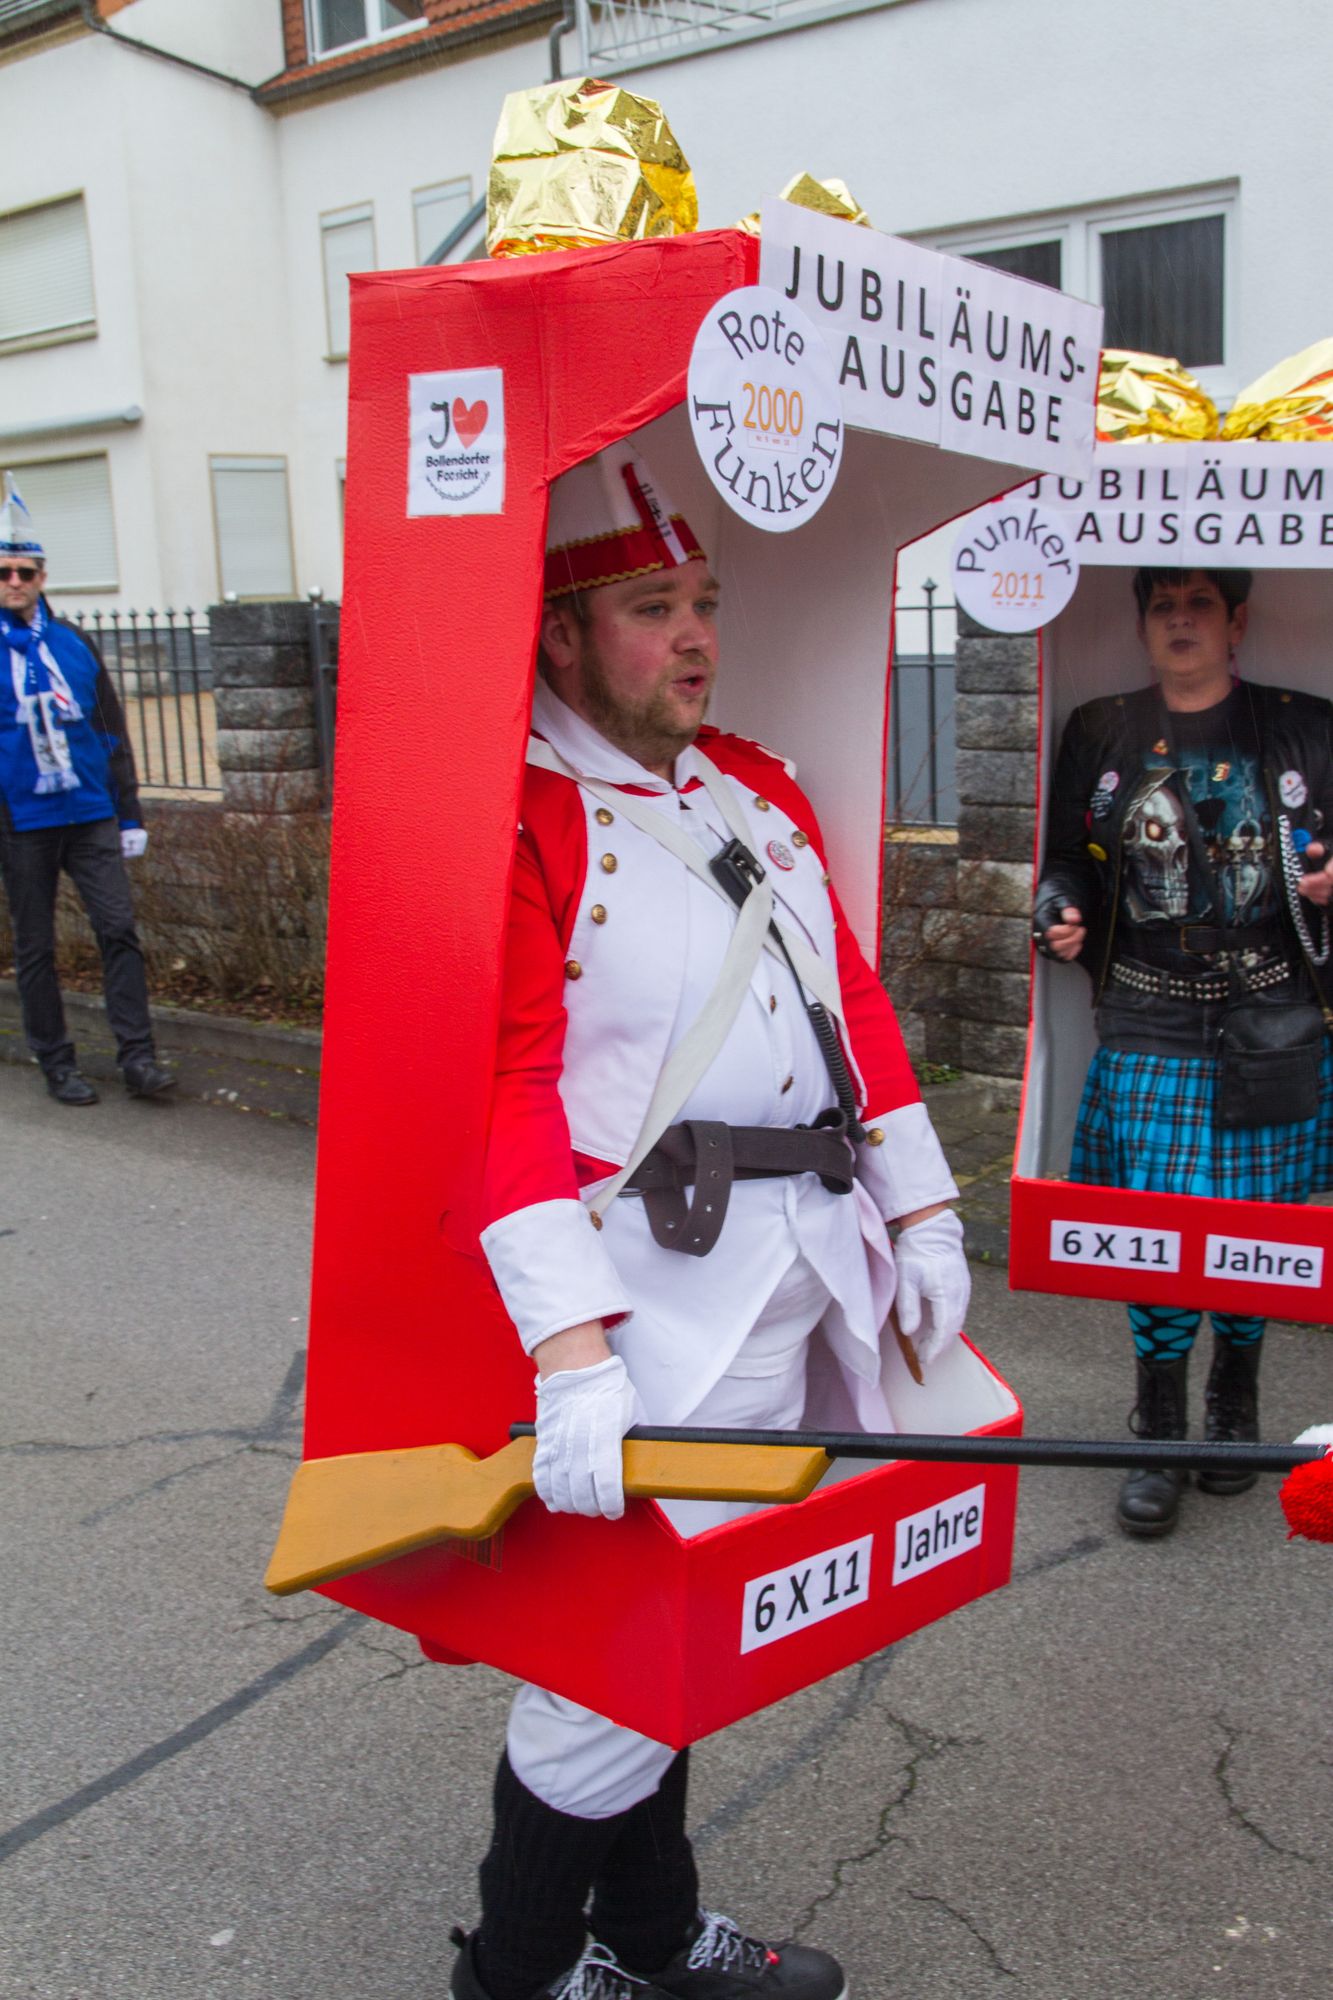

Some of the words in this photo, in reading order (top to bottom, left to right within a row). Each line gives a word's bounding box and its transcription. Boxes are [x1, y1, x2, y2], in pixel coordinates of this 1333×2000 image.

[717, 310, 805, 366] Rote
[785, 245, 1086, 383] JUBILÄUMS-
[742, 382, 804, 436] 2000
[838, 335, 1062, 443] AUSGABE
[426, 452, 490, 468] Bollendorfer
[693, 395, 840, 513] Funken
[956, 508, 1072, 576] Punker
[1075, 511, 1333, 546] AUSGABE
[991, 571, 1046, 599] 2011
[1062, 1229, 1082, 1256] 6
[1093, 1232, 1116, 1260] X
[1129, 1236, 1169, 1265] 11
[1213, 1243, 1314, 1279] Jahre
[901, 1504, 979, 1570] Jahre
[754, 1583, 776, 1634] 6
[786, 1569, 812, 1623] X
[822, 1550, 860, 1606] 11
